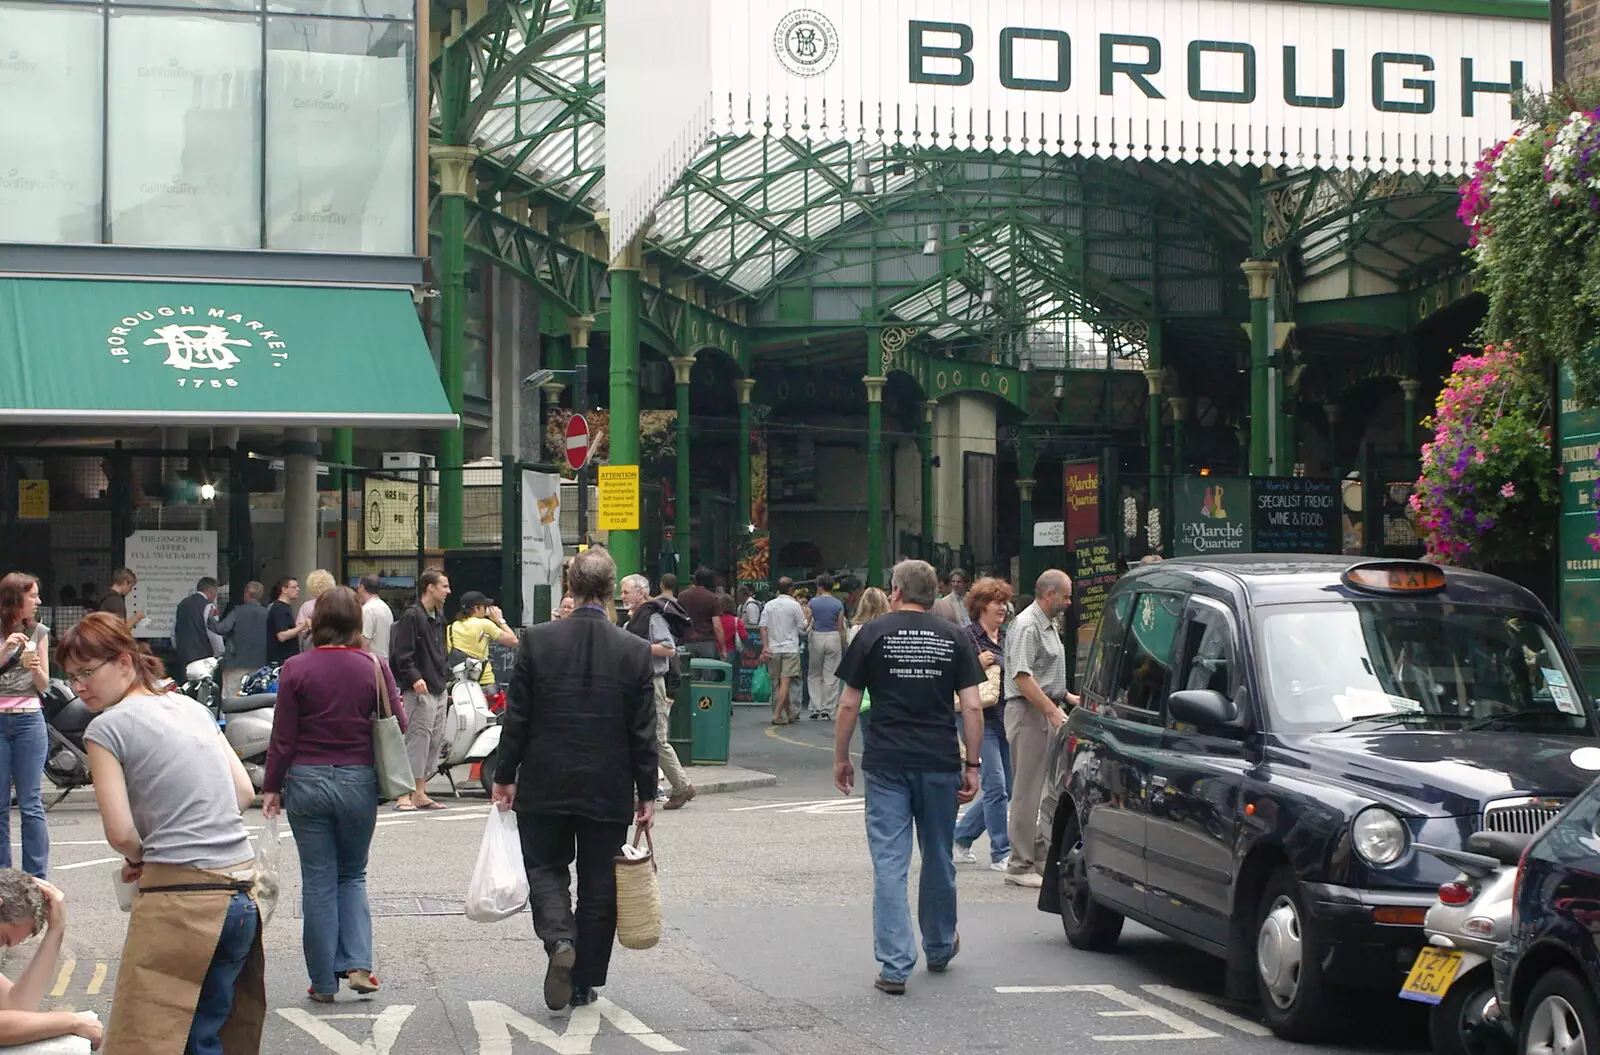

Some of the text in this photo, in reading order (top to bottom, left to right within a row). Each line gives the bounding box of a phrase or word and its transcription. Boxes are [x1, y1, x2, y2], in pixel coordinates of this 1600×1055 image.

[908, 20, 1523, 120] BOROUGH
[107, 305, 288, 360] BOROUGH MARKET
[1070, 473, 1099, 491] Marché
[1072, 492, 1099, 511] Quartier
[1258, 495, 1334, 509] SPECIALIST FRENCH
[1268, 512, 1324, 526] WINE & FOOD
[1182, 523, 1192, 532] Le
[1191, 522, 1243, 537] Marché
[141, 535, 156, 543] THE
[1181, 535, 1192, 544] du
[1192, 536, 1243, 552] Quartier
[131, 552, 212, 561] FULL TRACEABILITY
[156, 544, 186, 552] OFFERS
[1384, 569, 1428, 587] AXI
[1418, 950, 1462, 974] T277
[1409, 972, 1446, 993] AGJ
